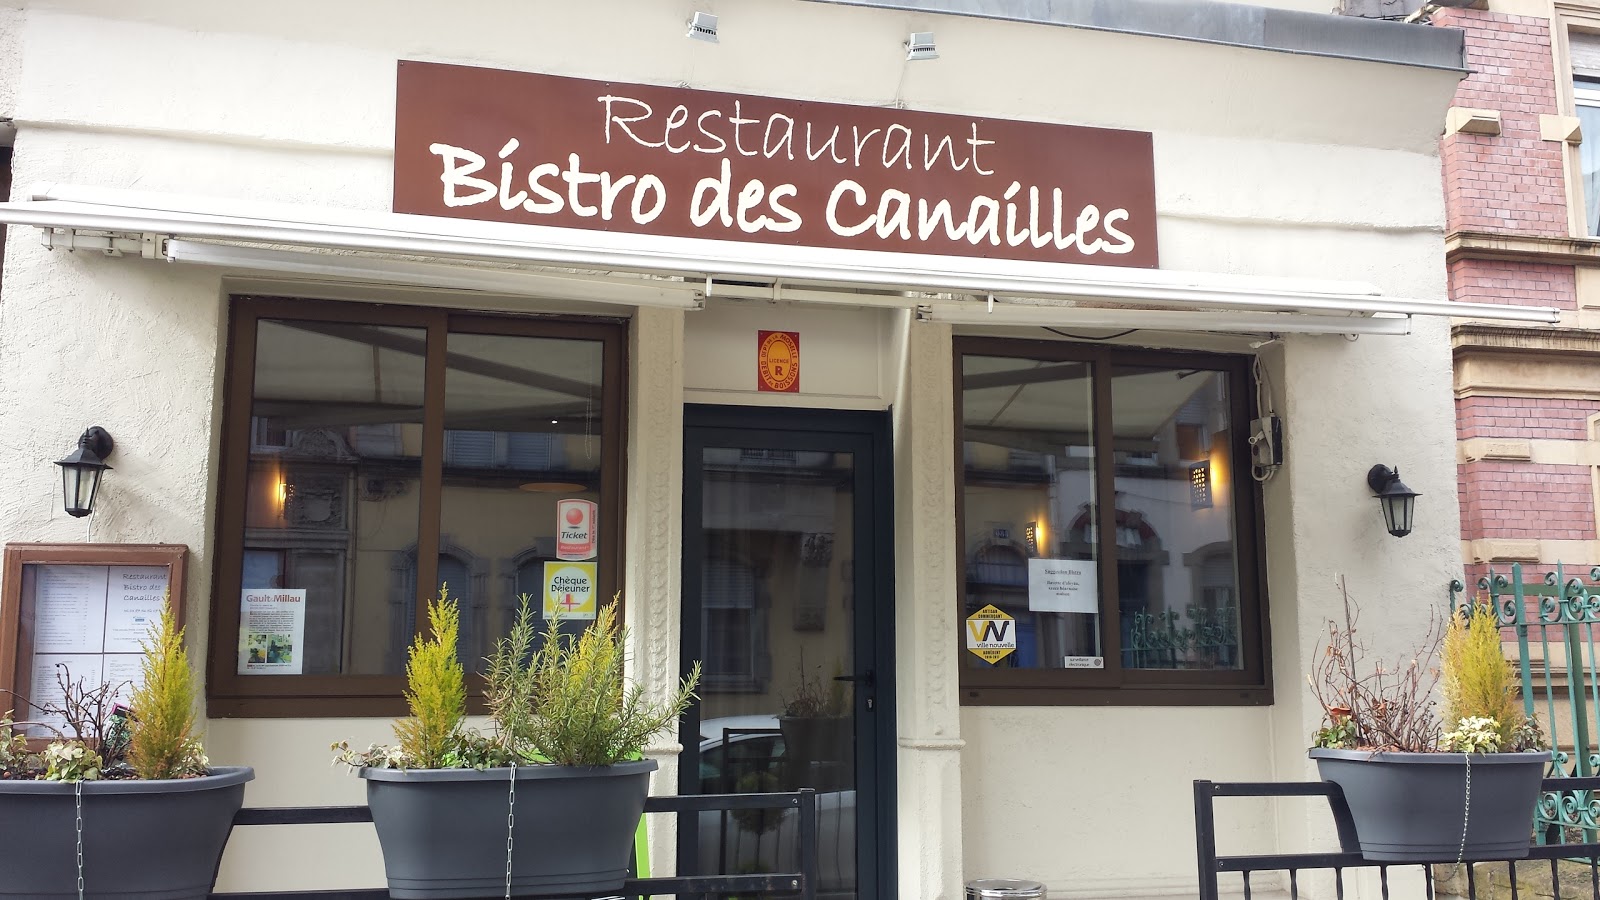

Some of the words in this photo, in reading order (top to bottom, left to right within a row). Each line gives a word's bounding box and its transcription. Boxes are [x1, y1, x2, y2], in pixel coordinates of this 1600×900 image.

[596, 94, 996, 176] Restaurant
[429, 138, 667, 225] Bistro
[690, 157, 803, 234] des
[825, 180, 1135, 256] Canailles
[780, 334, 798, 359] MOSELLE
[774, 365, 784, 376] R
[774, 362, 798, 389] BOISSONS
[561, 531, 588, 540] Ticket
[553, 576, 588, 586] Chèque
[123, 594, 161, 602] Canailles
